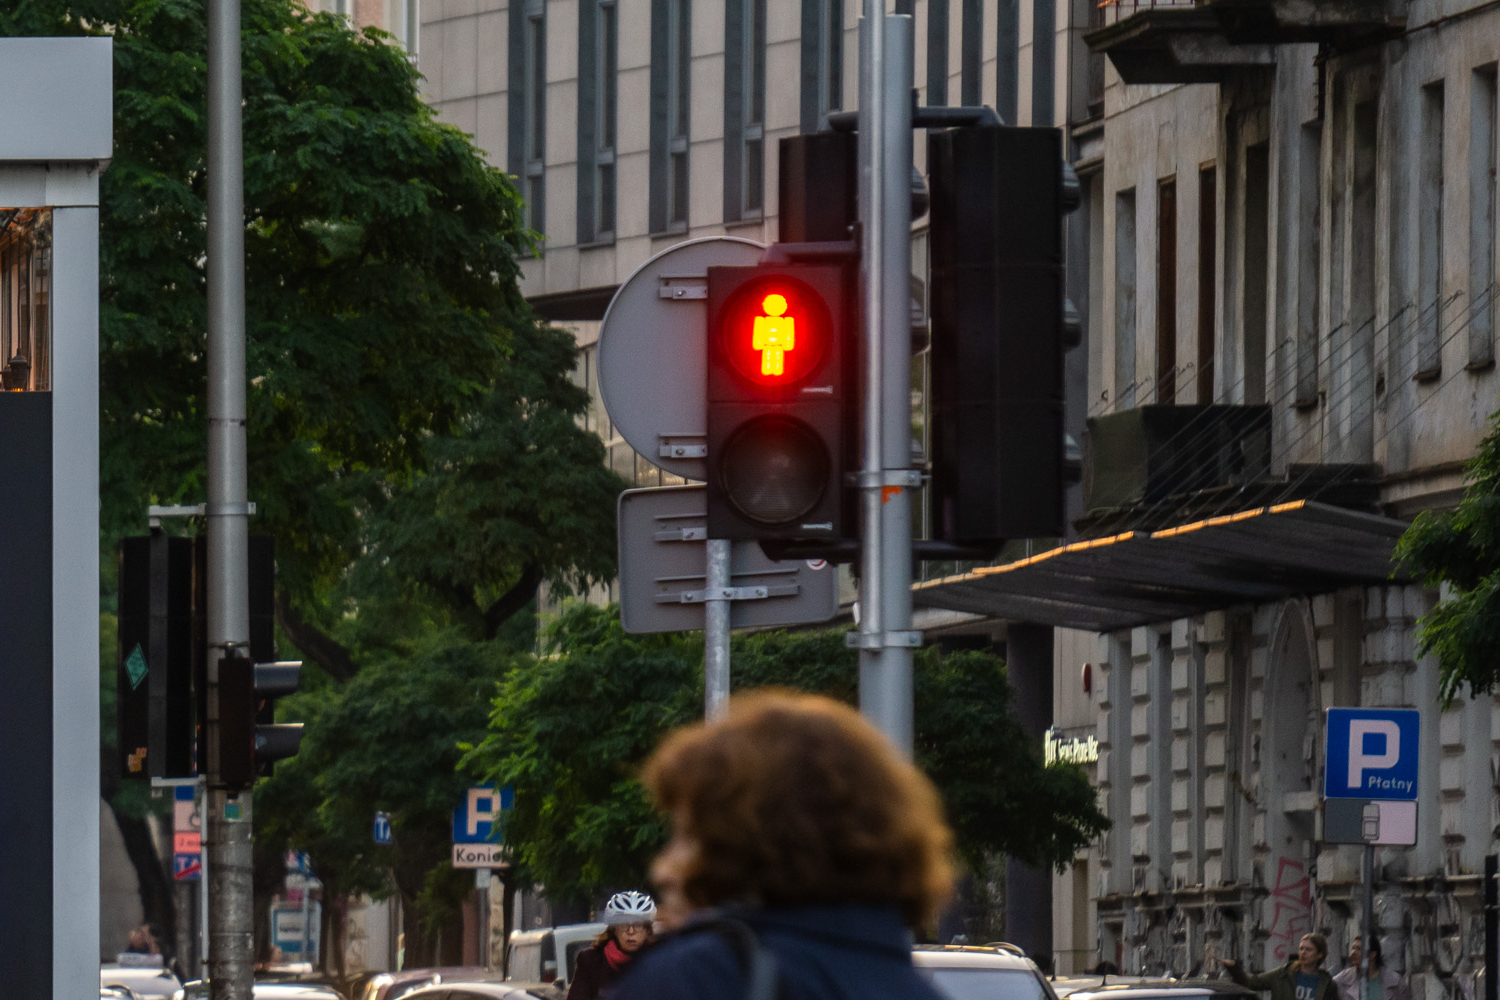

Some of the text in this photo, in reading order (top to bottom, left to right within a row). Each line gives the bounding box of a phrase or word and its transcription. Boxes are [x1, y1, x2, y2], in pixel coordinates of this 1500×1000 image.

[1347, 719, 1400, 788] P
[467, 788, 501, 835] P
[456, 846, 505, 862] Konie
